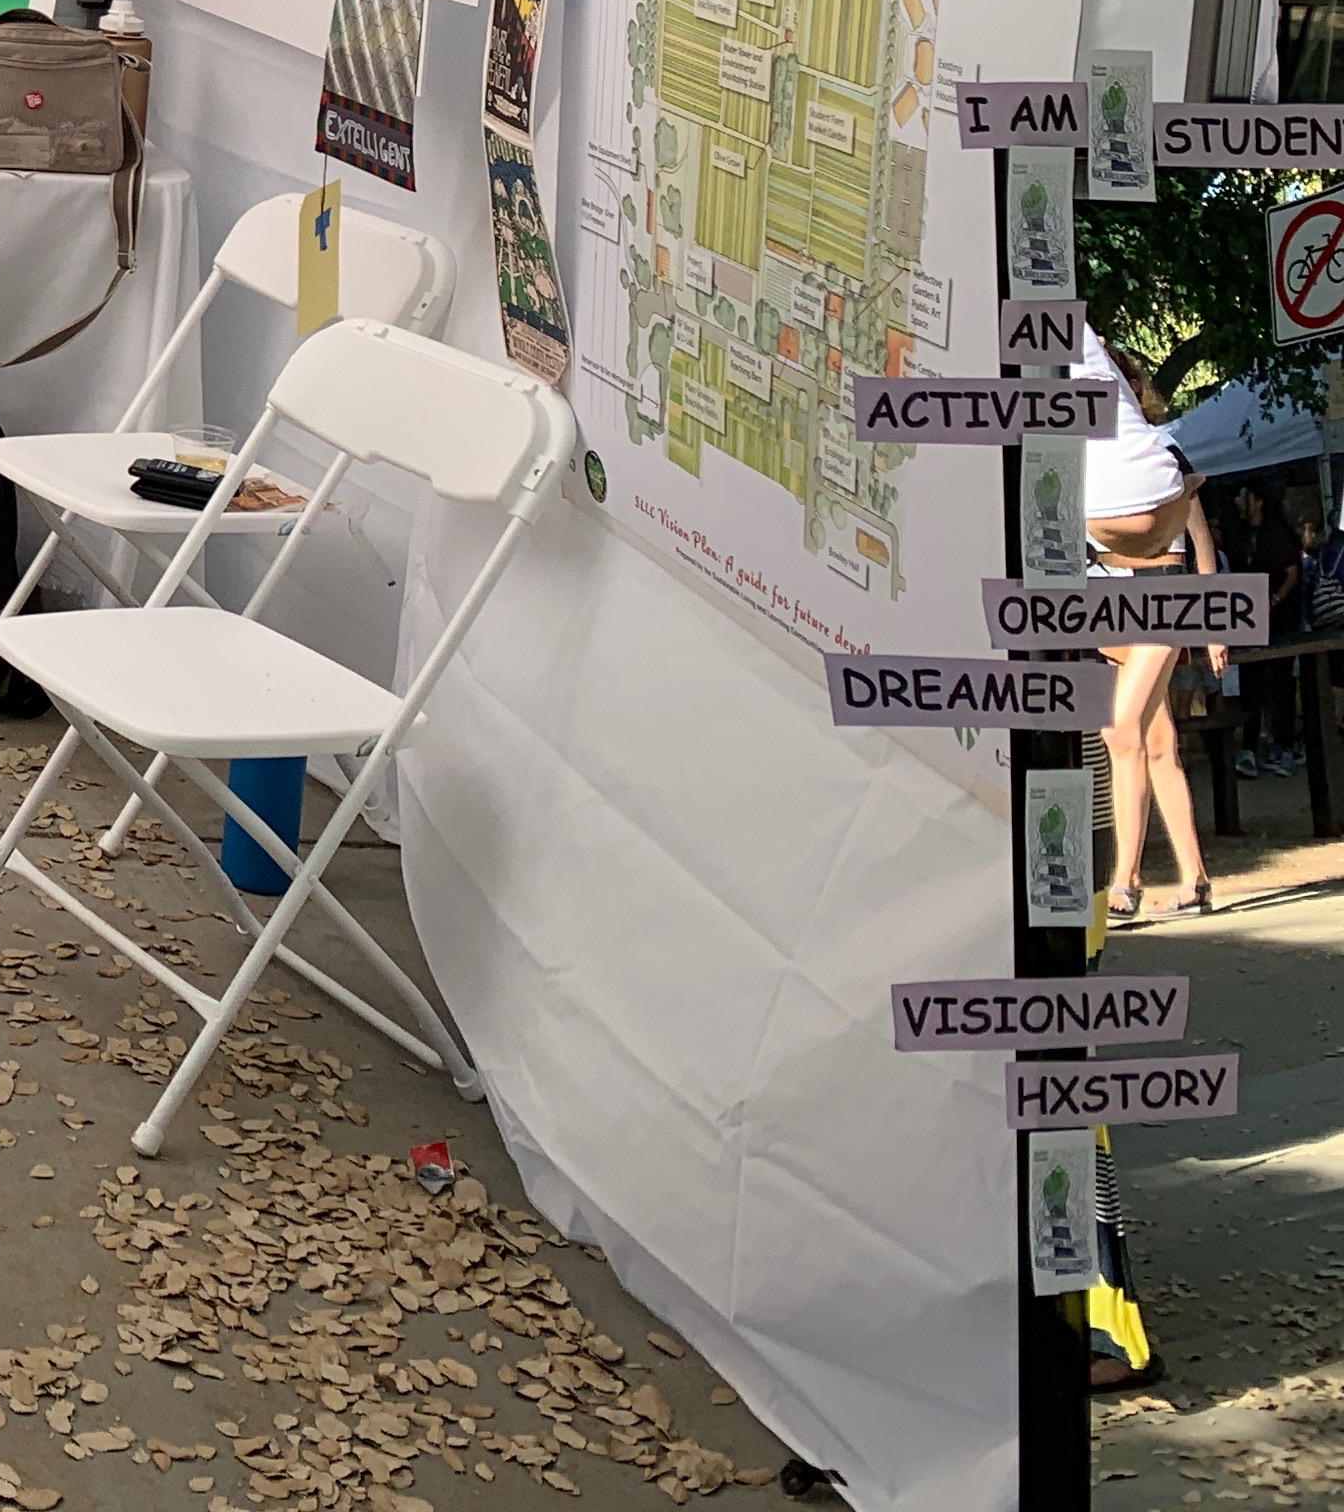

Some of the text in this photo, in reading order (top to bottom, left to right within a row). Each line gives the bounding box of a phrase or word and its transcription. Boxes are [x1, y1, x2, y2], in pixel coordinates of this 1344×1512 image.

[965, 93, 1079, 134] I AM
[325, 110, 410, 172] EXTELLIGENT
[1008, 311, 1074, 352] AN
[867, 390, 1109, 429] ACTIVIST
[635, 495, 831, 638] SLLC Vision Plan: A guide for future
[998, 591, 1256, 636] ORGANIZER
[842, 666, 1076, 714] DREAMER
[902, 987, 1178, 1038] VISIONARY
[1017, 1066, 1227, 1117] HXSTORY
